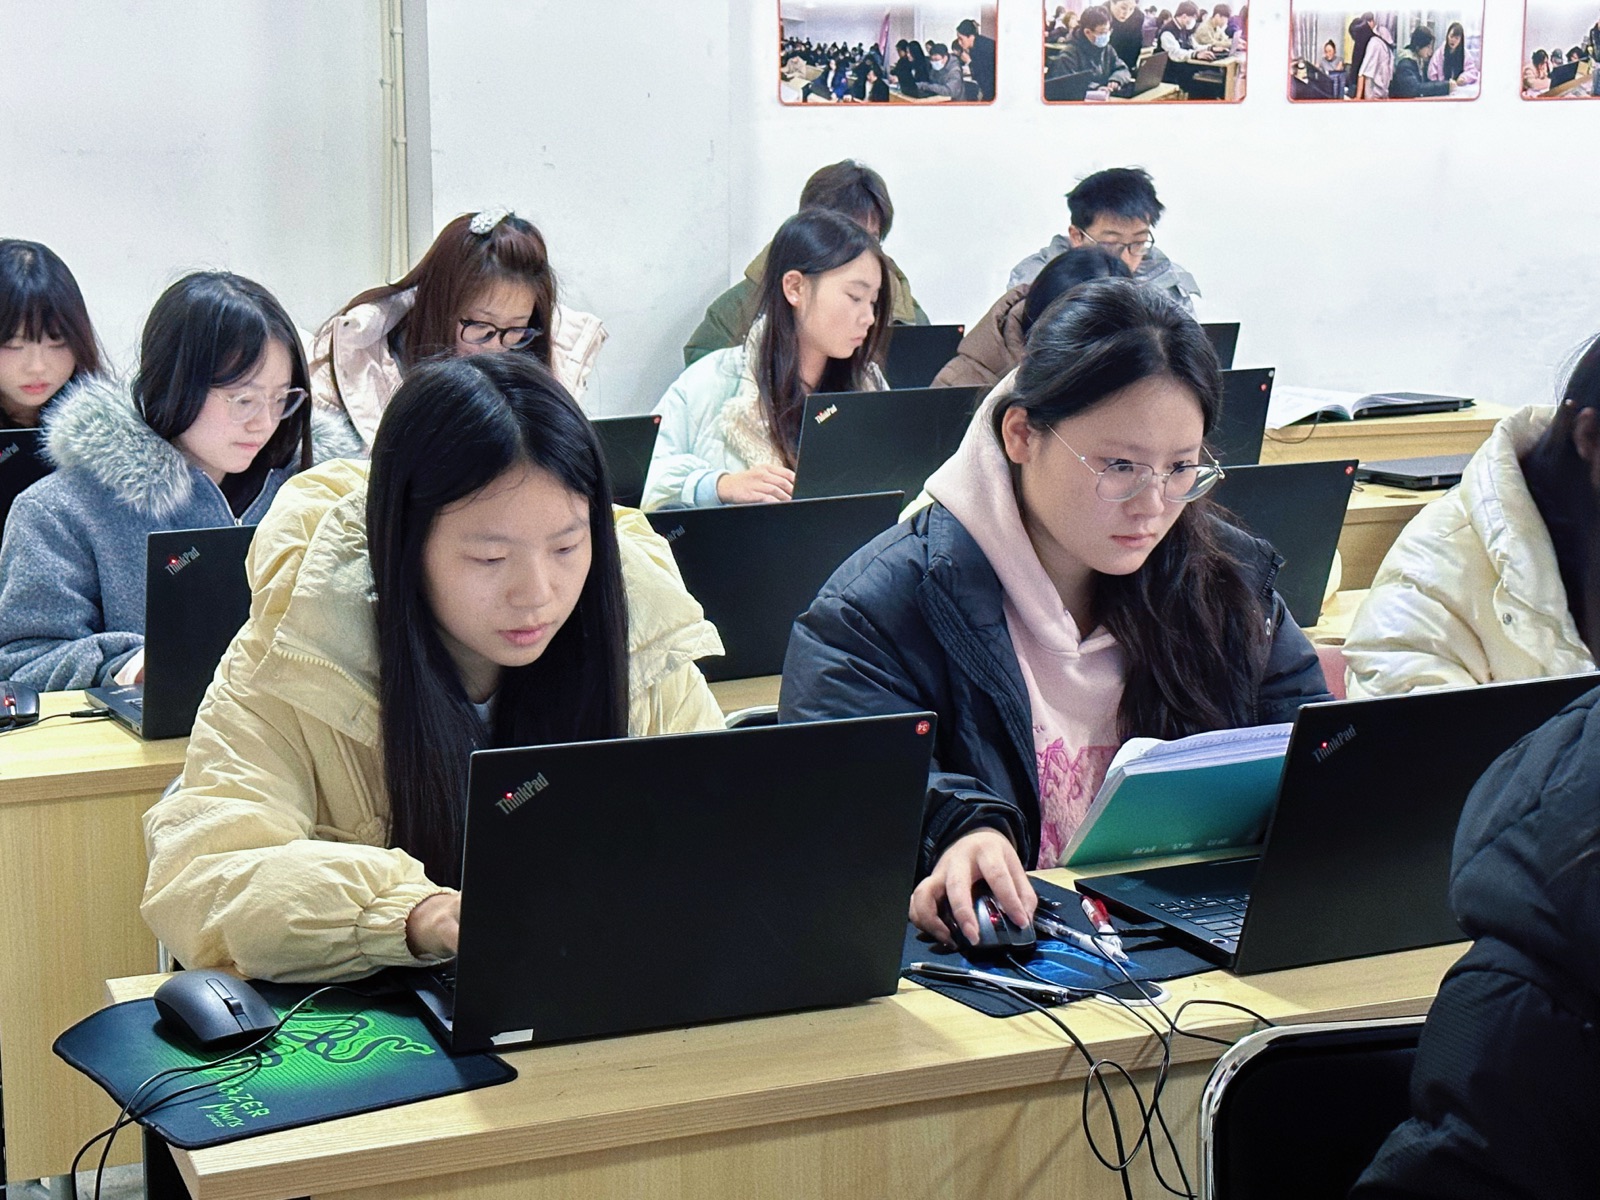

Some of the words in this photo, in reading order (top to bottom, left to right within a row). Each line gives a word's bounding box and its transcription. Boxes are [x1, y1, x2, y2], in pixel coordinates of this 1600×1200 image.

[164, 546, 200, 576] ThinkPad
[1312, 723, 1357, 763] ThinkPad
[494, 771, 550, 815] ThinkPad
